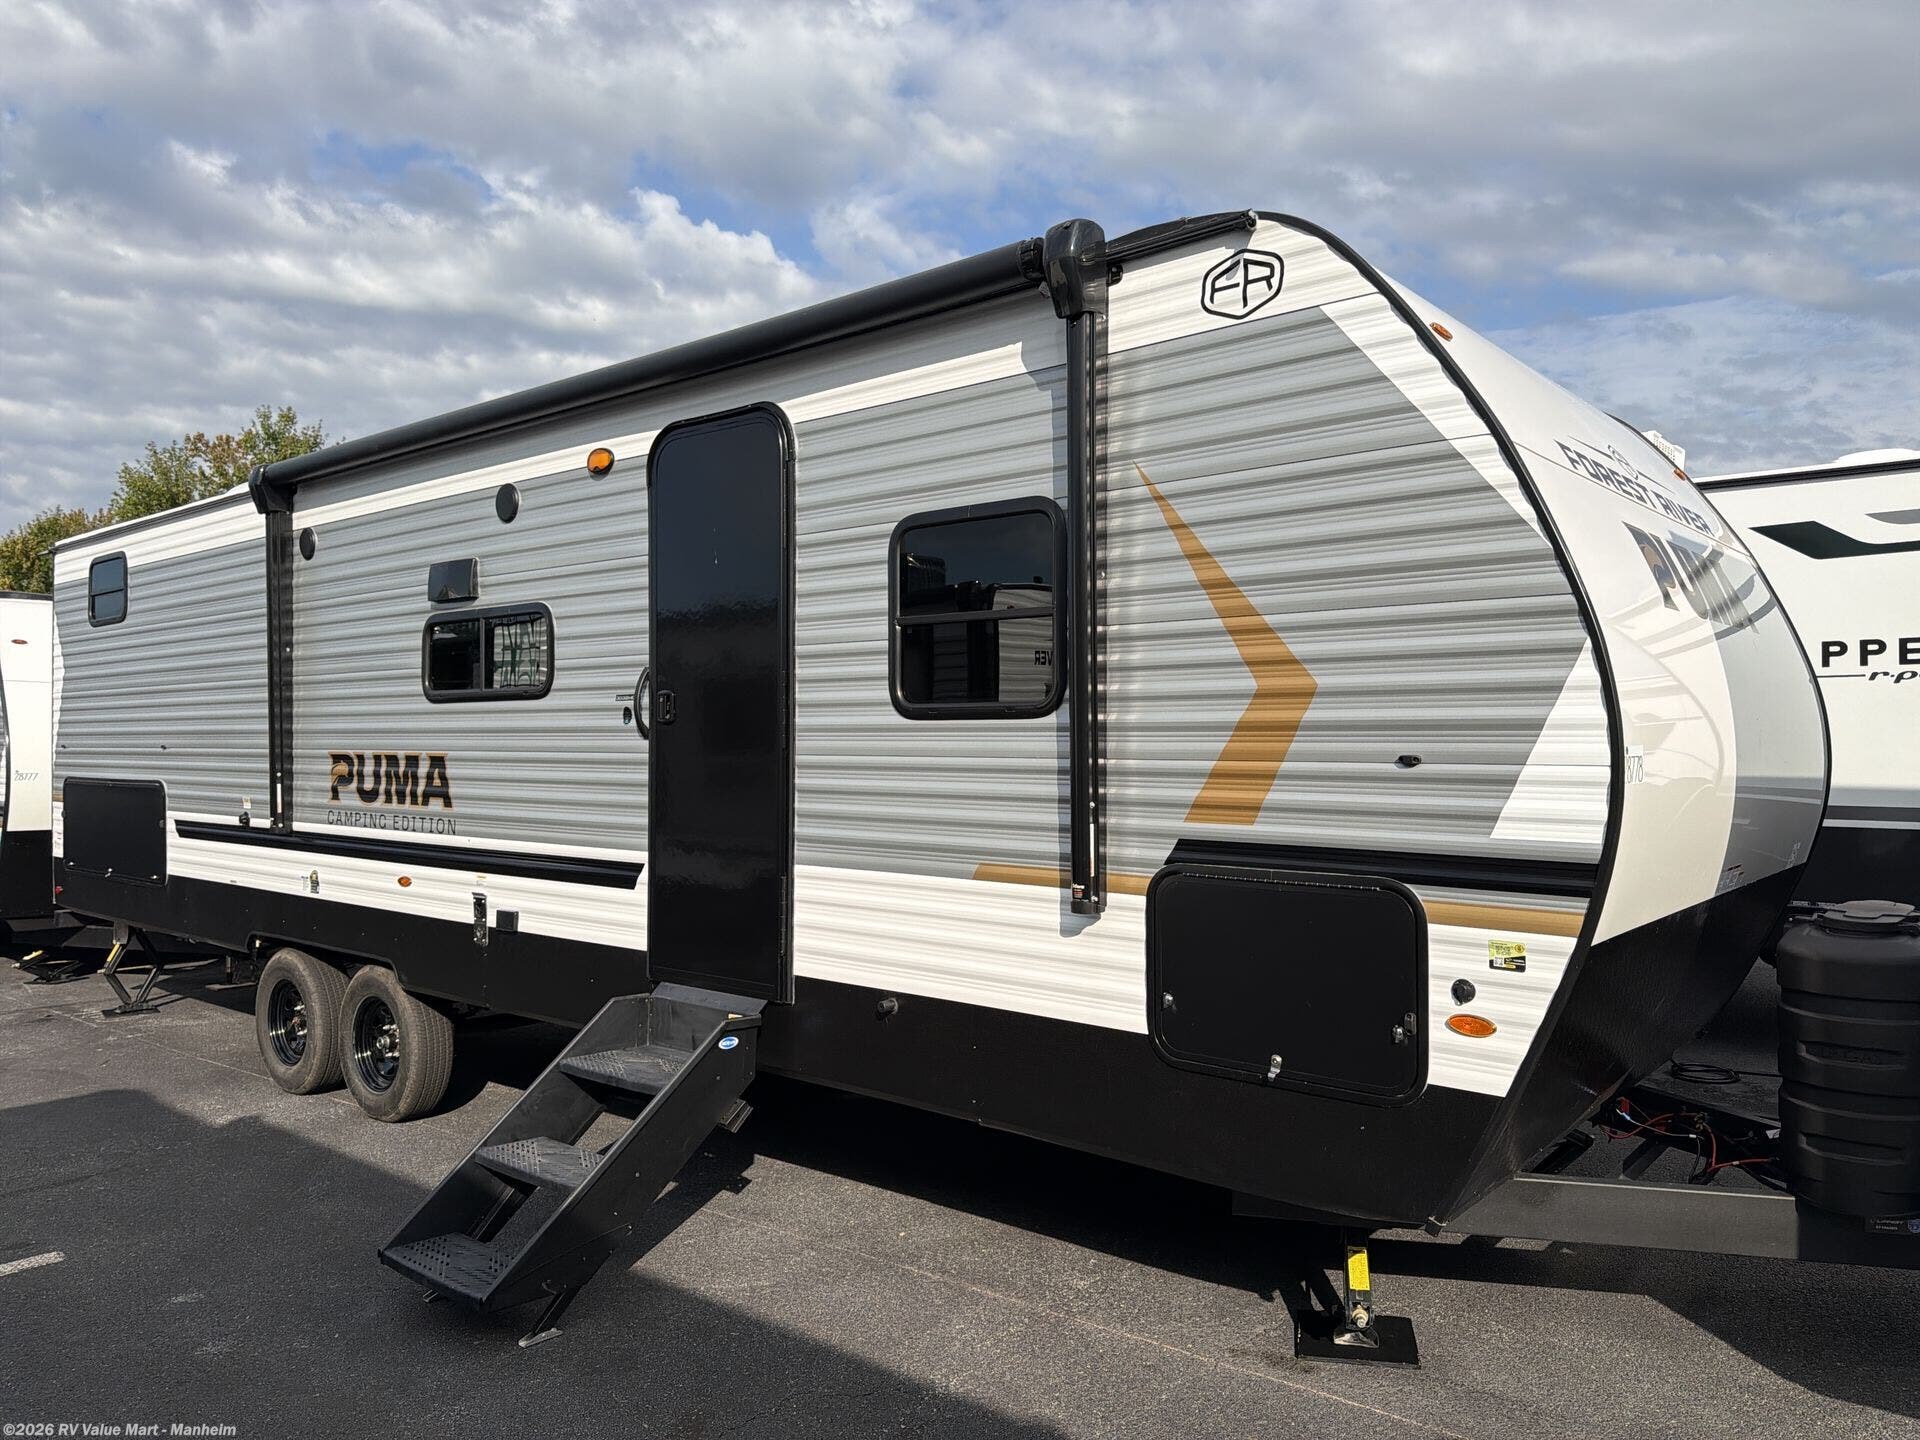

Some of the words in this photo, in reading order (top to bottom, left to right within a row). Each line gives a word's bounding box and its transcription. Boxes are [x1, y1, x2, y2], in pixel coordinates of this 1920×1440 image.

[1553, 439, 1658, 510] FOREST
[1651, 489, 1716, 538] RIVER
[327, 752, 455, 812] PUMA
[327, 810, 387, 829] CAMPING
[393, 815, 457, 835] EDITION
